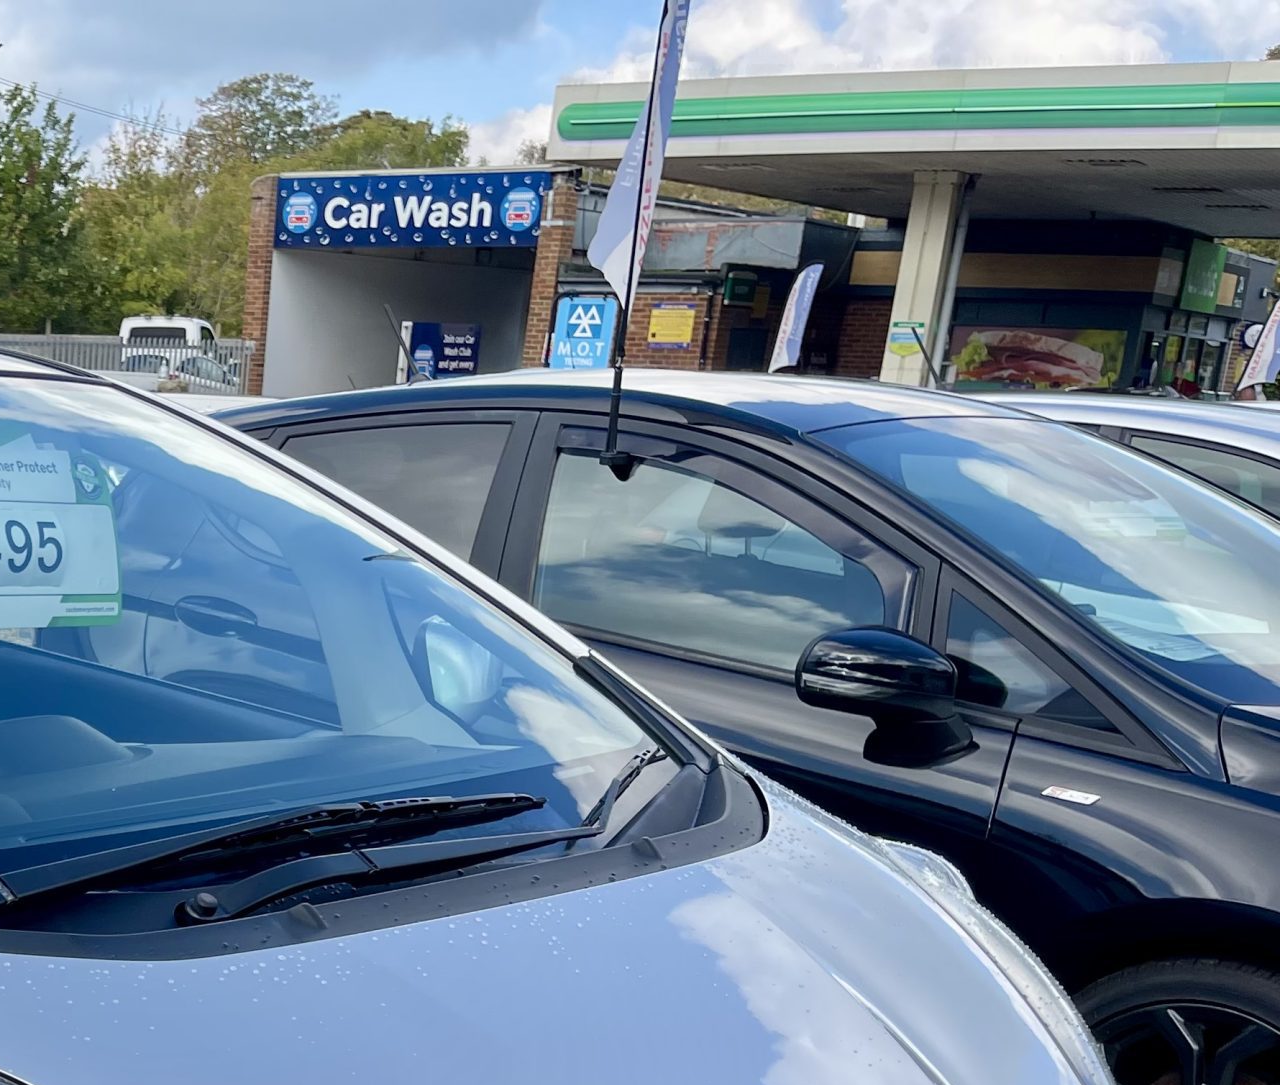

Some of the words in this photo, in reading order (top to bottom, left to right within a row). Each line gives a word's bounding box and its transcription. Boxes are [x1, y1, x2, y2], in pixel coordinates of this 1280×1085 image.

[323, 196, 386, 230] Car
[393, 192, 494, 229] Wash
[17, 460, 57, 475] Protect
